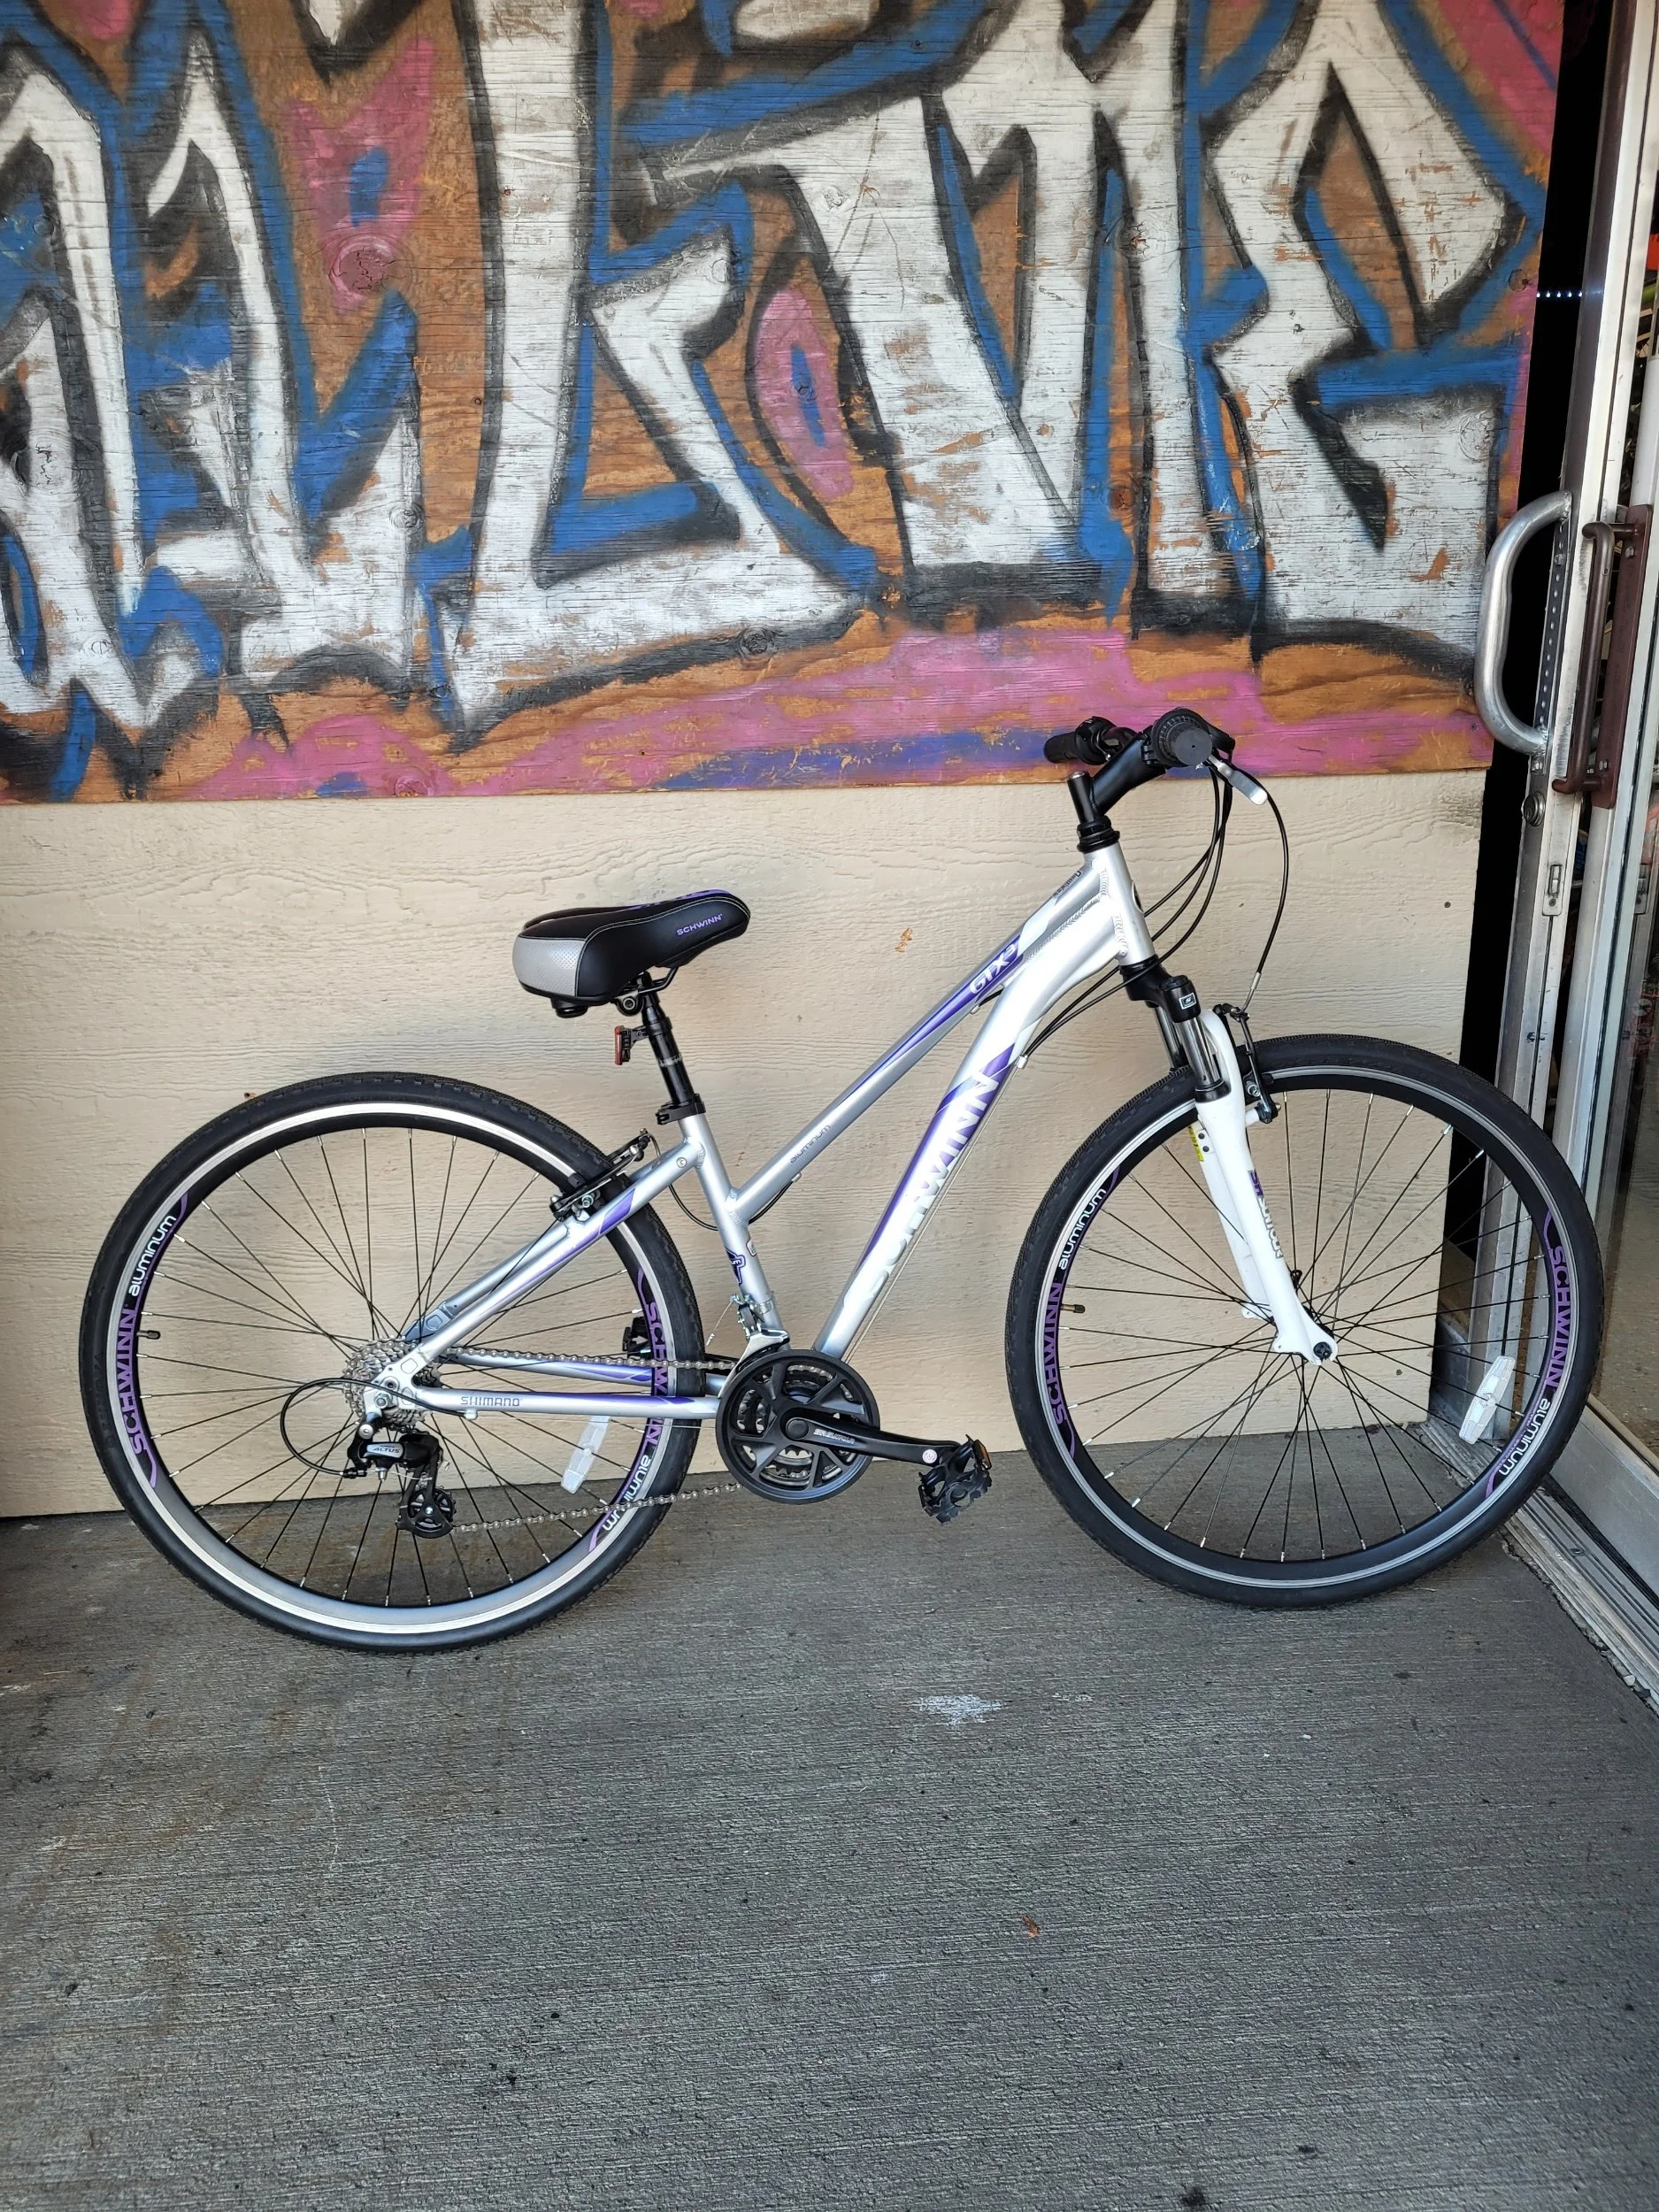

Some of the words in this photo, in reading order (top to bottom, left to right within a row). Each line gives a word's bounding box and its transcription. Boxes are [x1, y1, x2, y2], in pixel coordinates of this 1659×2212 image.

[676, 913, 722, 935] SCHWINN
[790, 1125, 831, 1164] aluminum
[128, 1215, 177, 1296] aluminum
[1059, 1188, 1106, 1270] aluminum
[1044, 1283, 1066, 1425] SCHWINN
[1547, 1245, 1571, 1388] SCHWINN
[116, 1308, 145, 1455] SCHWINN
[461, 1396, 520, 1407] SHIMANO
[645, 1301, 669, 1449] SCHWN
[1499, 1398, 1550, 1476] aluminum
[602, 1454, 651, 1531] alumium
